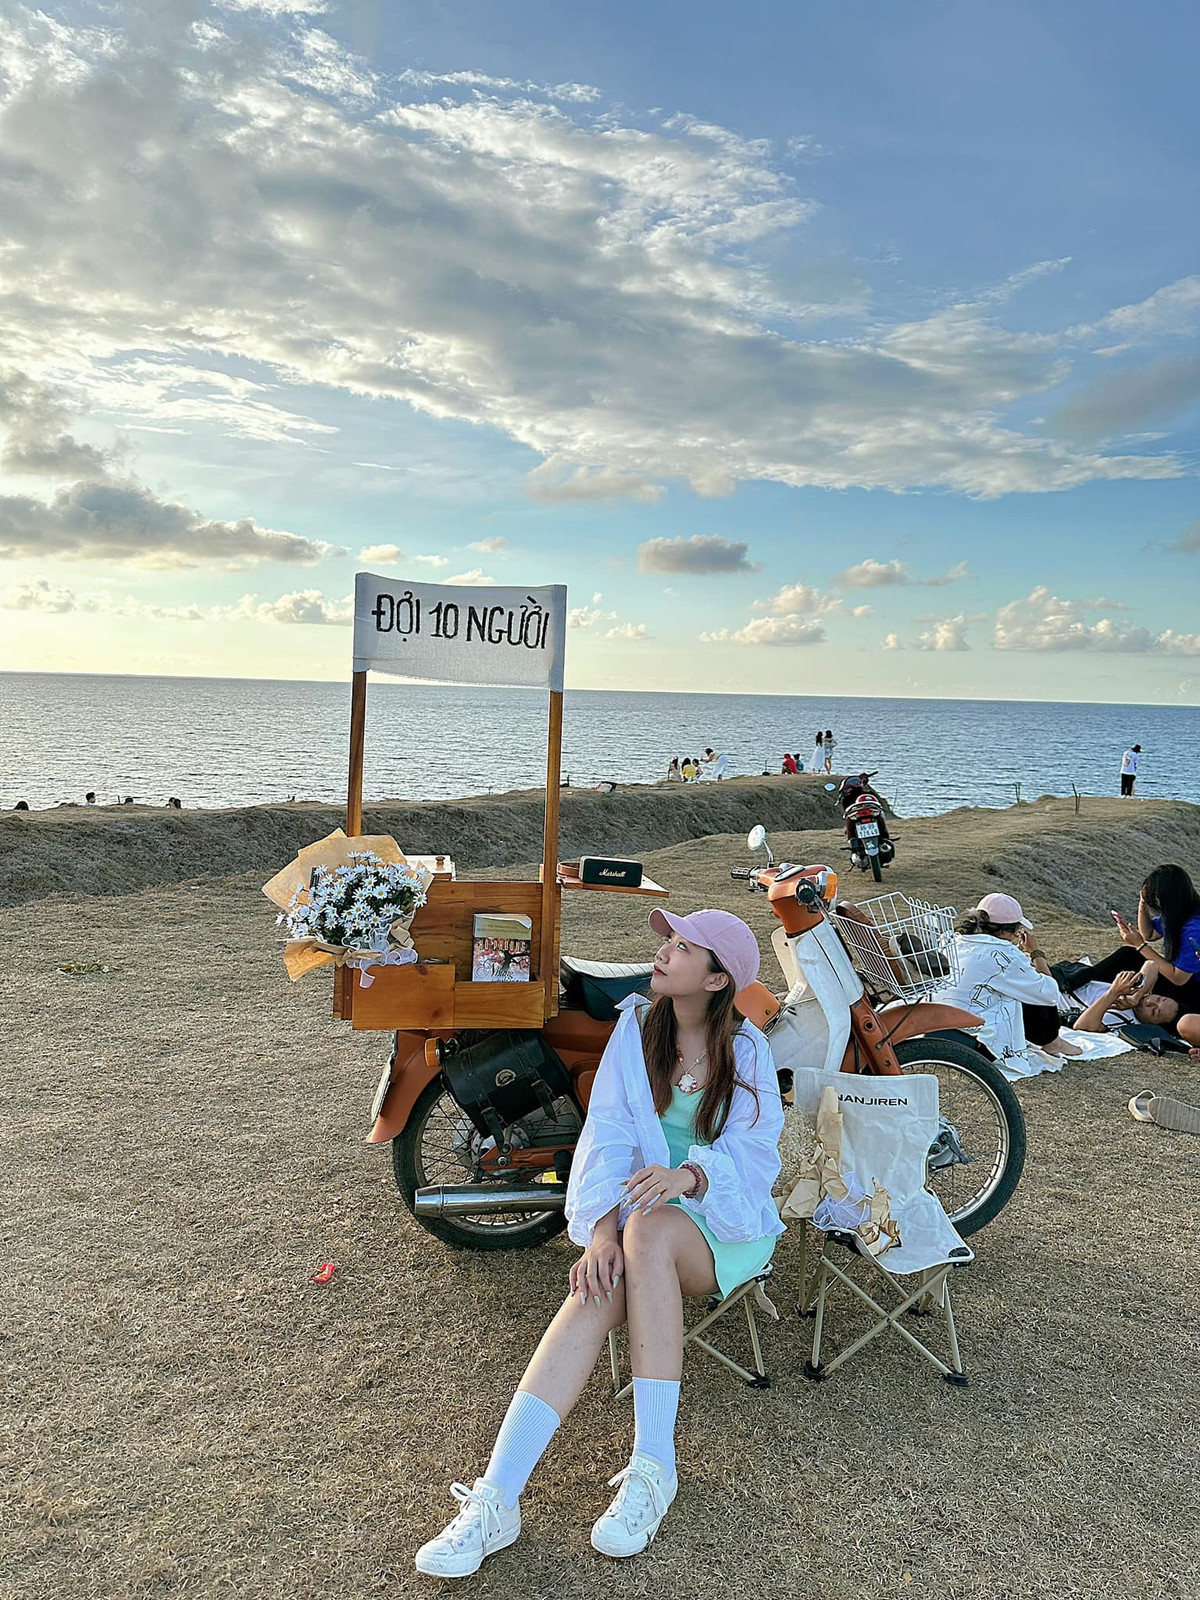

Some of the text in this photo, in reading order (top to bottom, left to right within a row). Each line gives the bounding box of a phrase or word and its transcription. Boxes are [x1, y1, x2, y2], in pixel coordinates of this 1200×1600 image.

[428, 601, 460, 639] 10
[466, 595, 551, 649] NGƯỜI
[598, 868, 627, 878] Marshall
